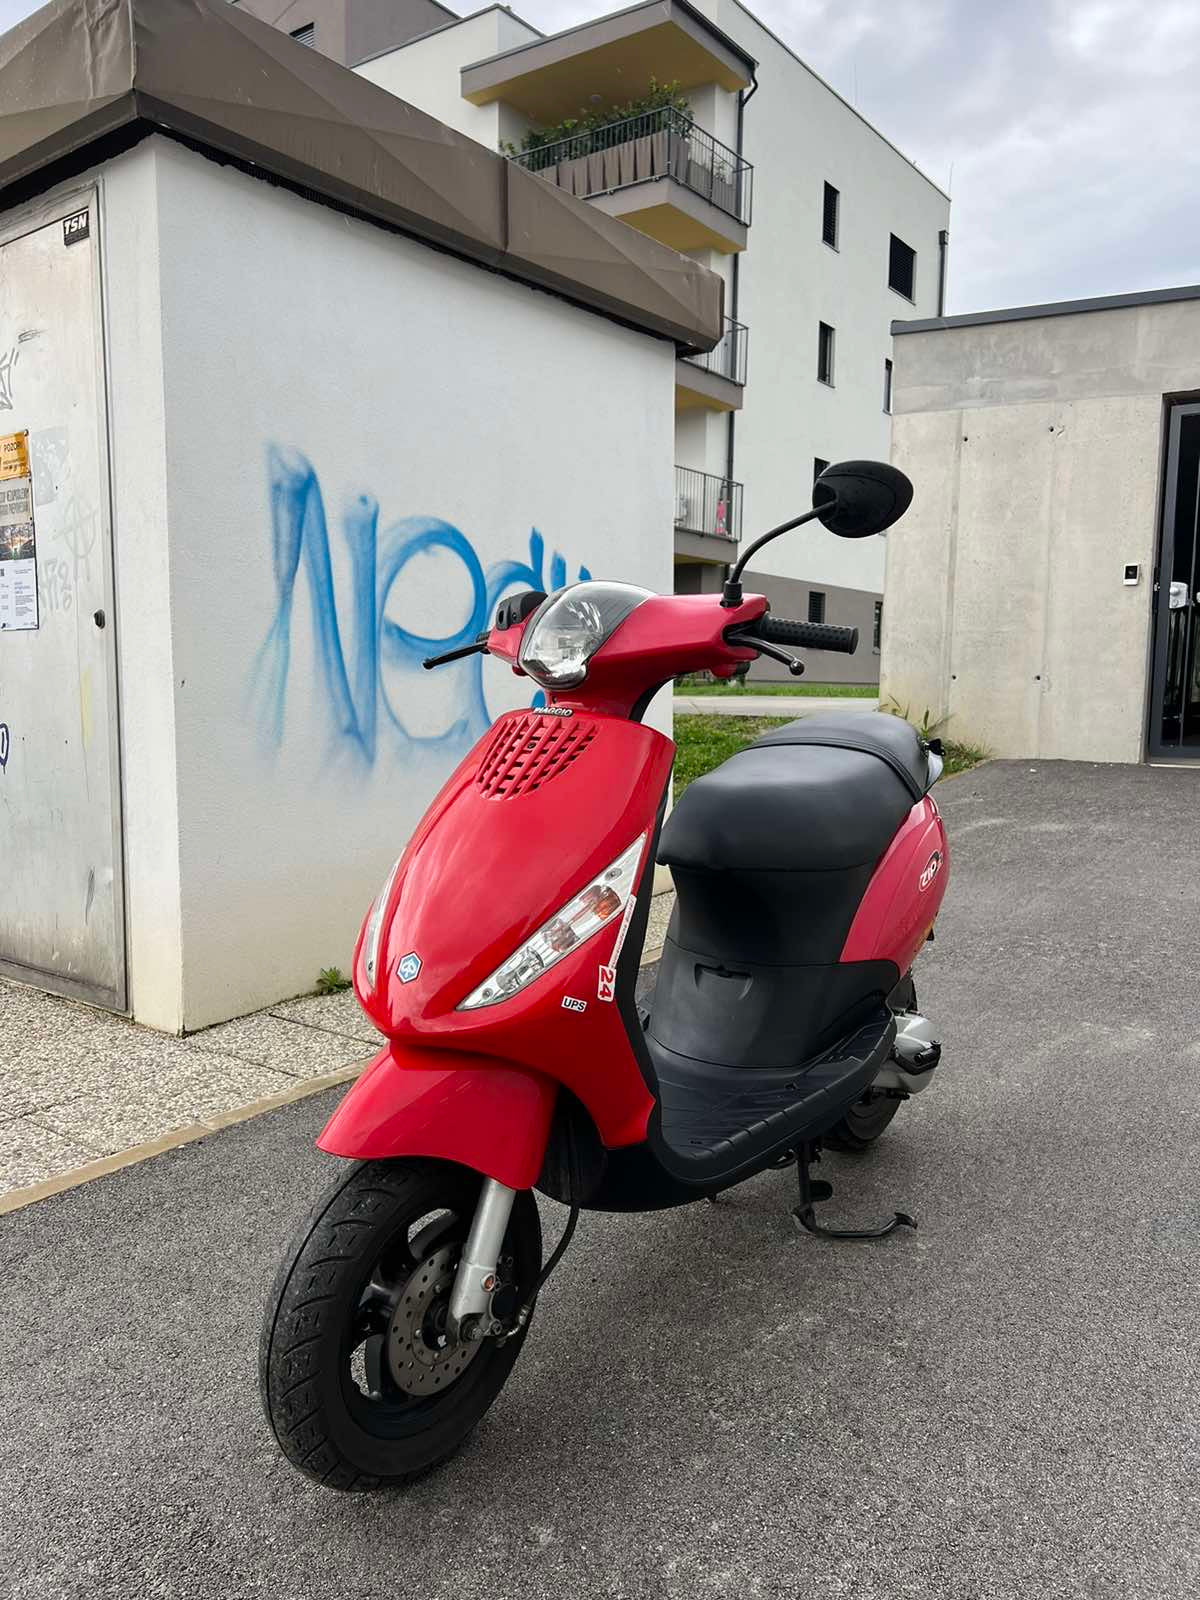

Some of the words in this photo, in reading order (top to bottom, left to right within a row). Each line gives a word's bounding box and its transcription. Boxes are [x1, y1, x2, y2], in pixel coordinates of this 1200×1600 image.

[65, 213, 87, 235] TSN
[534, 707, 573, 716] PIAGGIO
[600, 967, 614, 997] 24
[563, 998, 586, 1011] UPS
